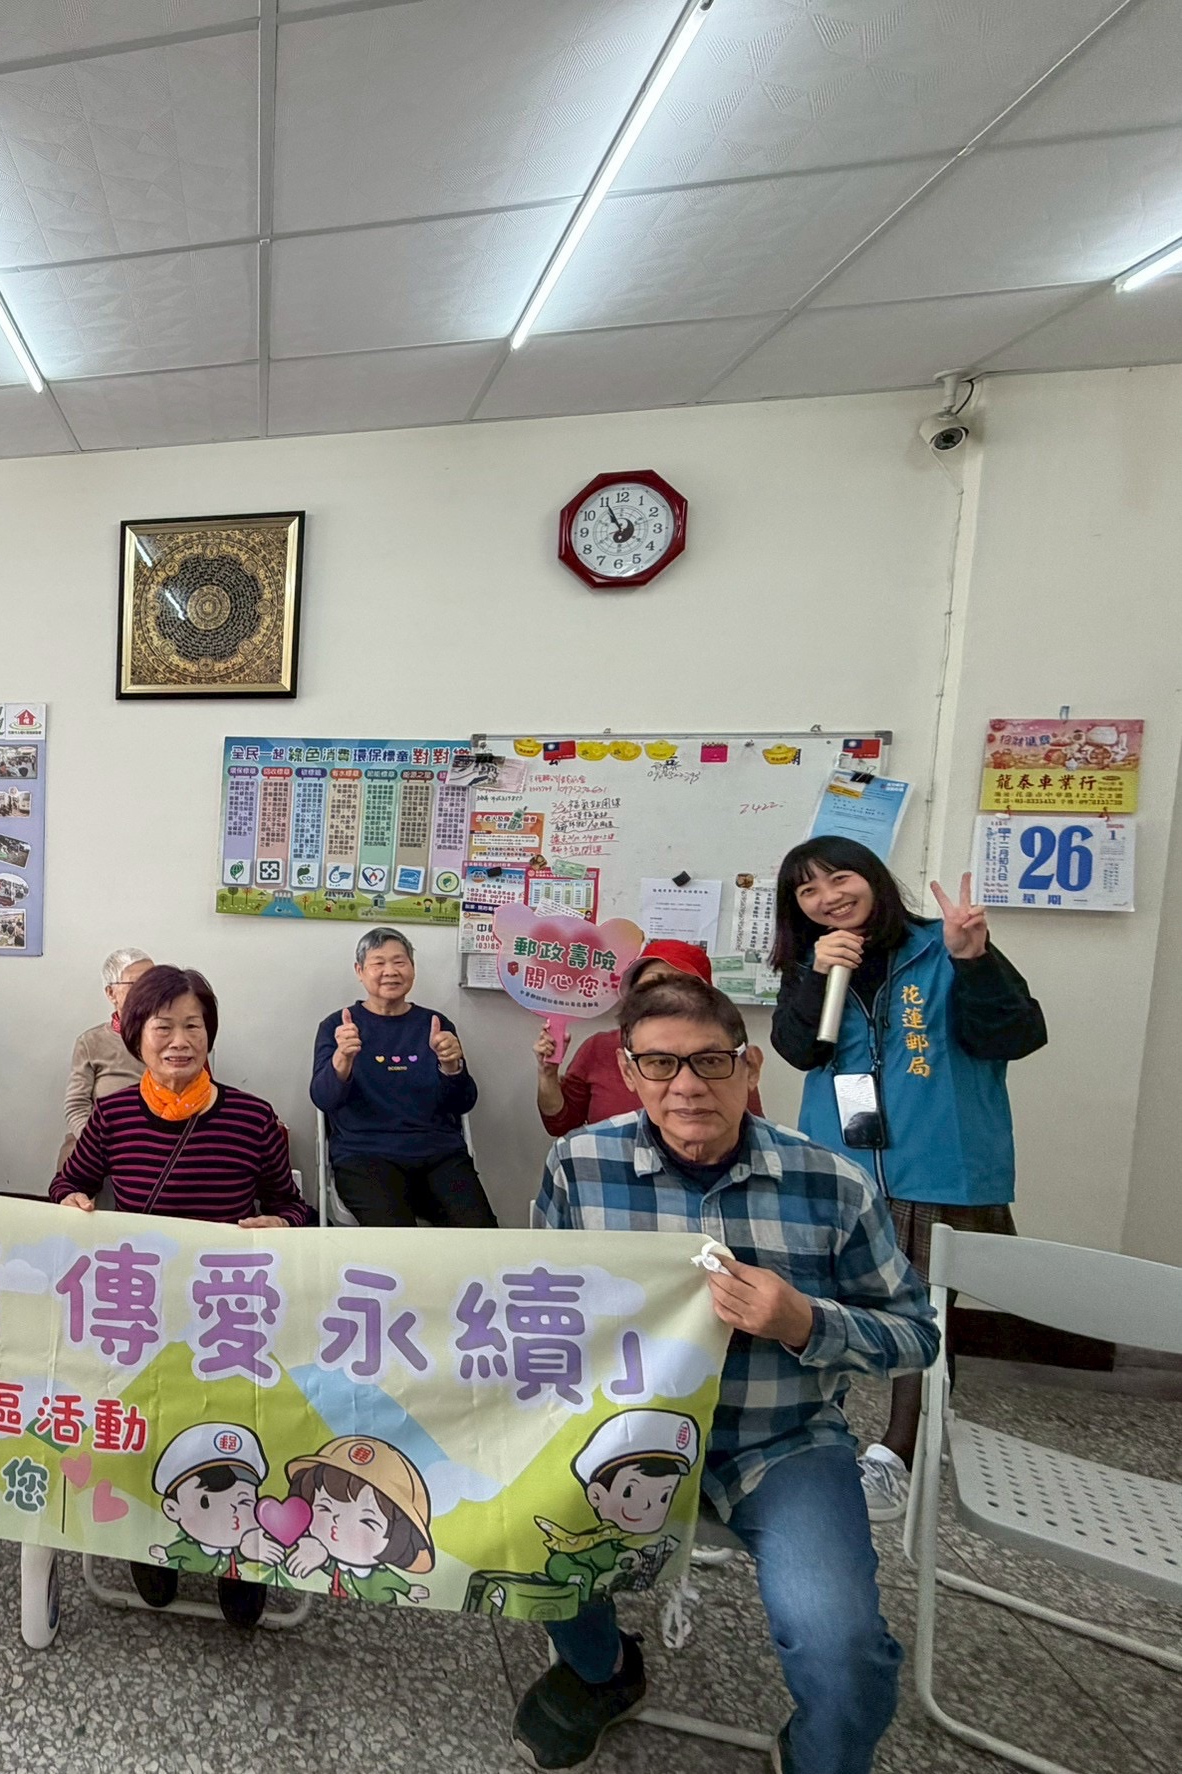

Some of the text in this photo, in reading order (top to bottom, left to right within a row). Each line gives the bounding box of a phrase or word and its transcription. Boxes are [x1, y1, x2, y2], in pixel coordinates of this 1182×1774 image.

[599, 497, 610, 507] 11
[616, 491, 630, 503] 12
[638, 495, 644, 506] 1
[583, 510, 596, 521] 10
[649, 507, 659, 517] 2
[580, 527, 589, 538] 9
[653, 523, 663, 534] 3
[583, 544, 592, 554] 8
[645, 541, 655, 551] 4
[596, 555, 606, 566] 7
[613, 559, 623, 569] 6
[632, 554, 641, 564] 5
[995, 774, 1097, 791] 龍泰車業行
[1018, 825, 1093, 891] 26
[1022, 893, 1088, 906] 星期一
[513, 937, 618, 972] 郵政壽險
[523, 966, 600, 998] 關心您
[900, 984, 931, 1078] 花蓮郵局
[55, 1241, 644, 1405] 傳愛永續」
